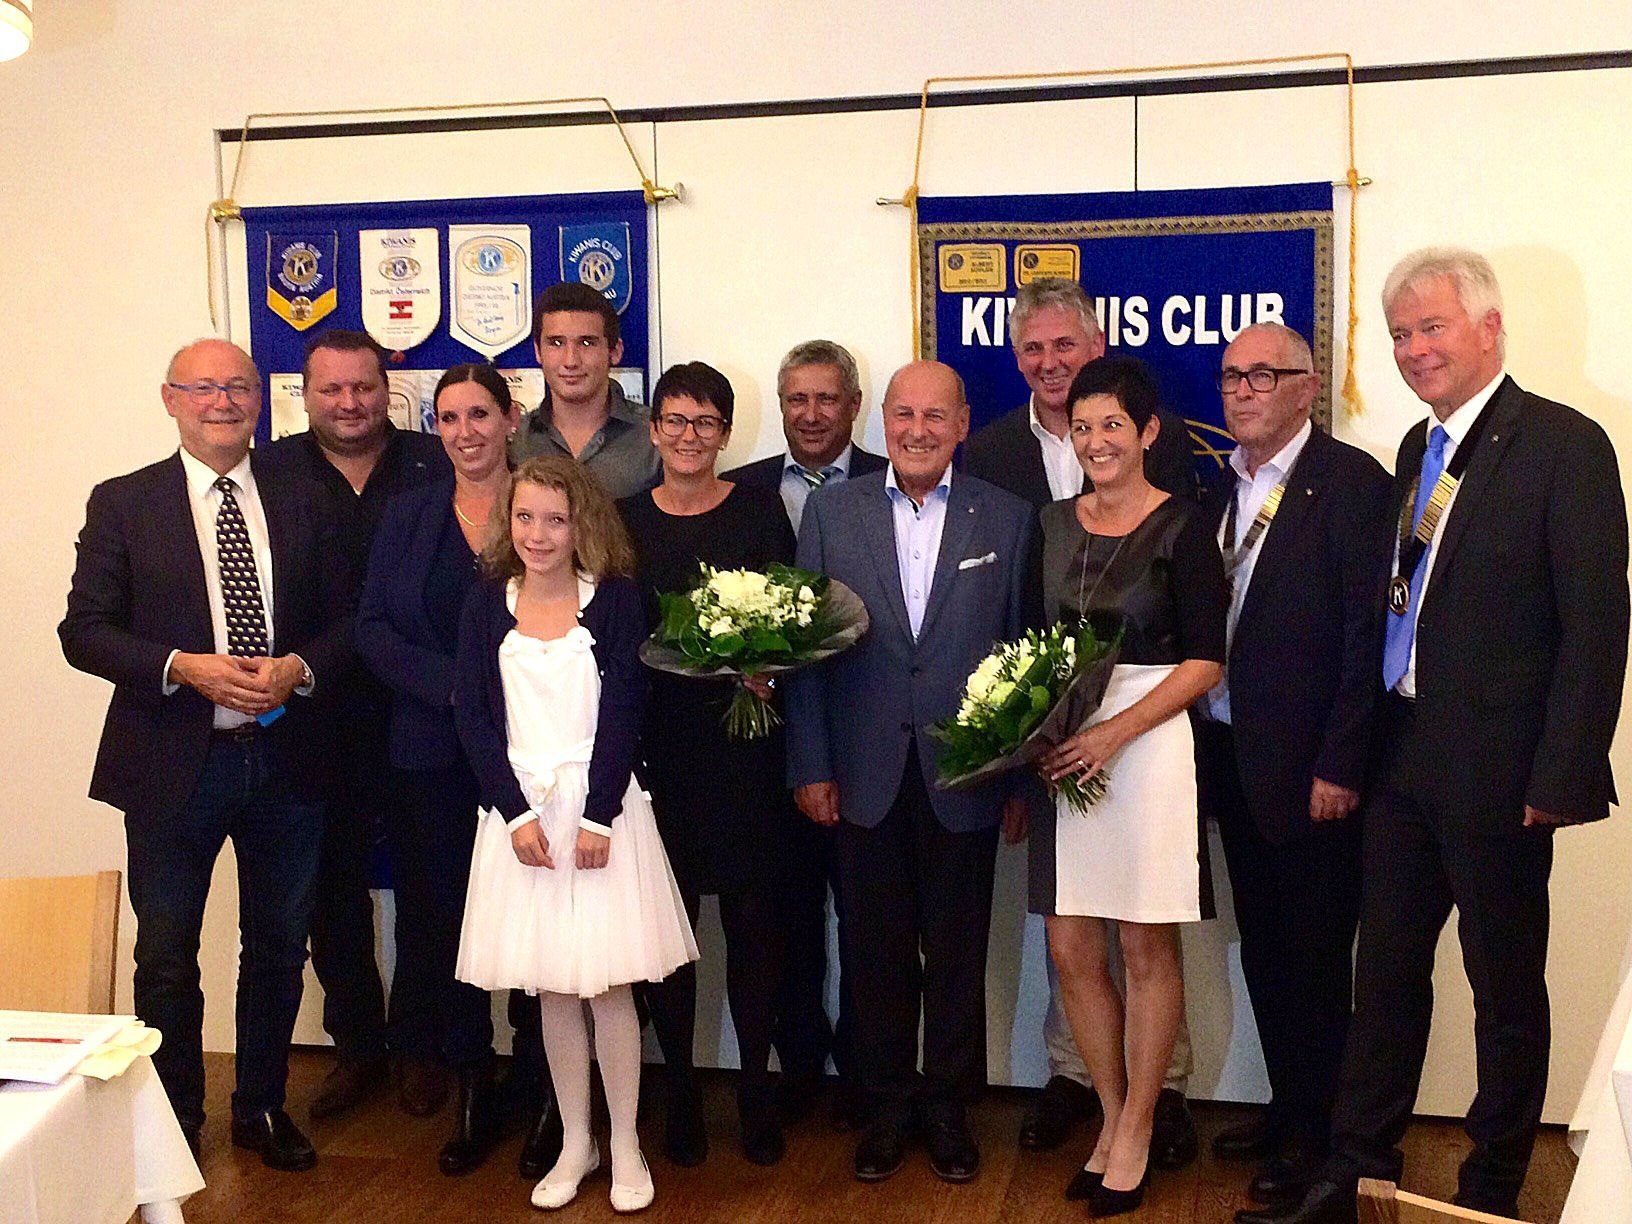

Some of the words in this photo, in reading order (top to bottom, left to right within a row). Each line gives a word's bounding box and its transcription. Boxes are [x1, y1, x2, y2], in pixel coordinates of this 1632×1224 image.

[568, 238, 601, 263] KIWANIS
[602, 240, 622, 261] CLUB
[962, 295, 1149, 346] KIIS
[1162, 292, 1285, 346] CLUB
